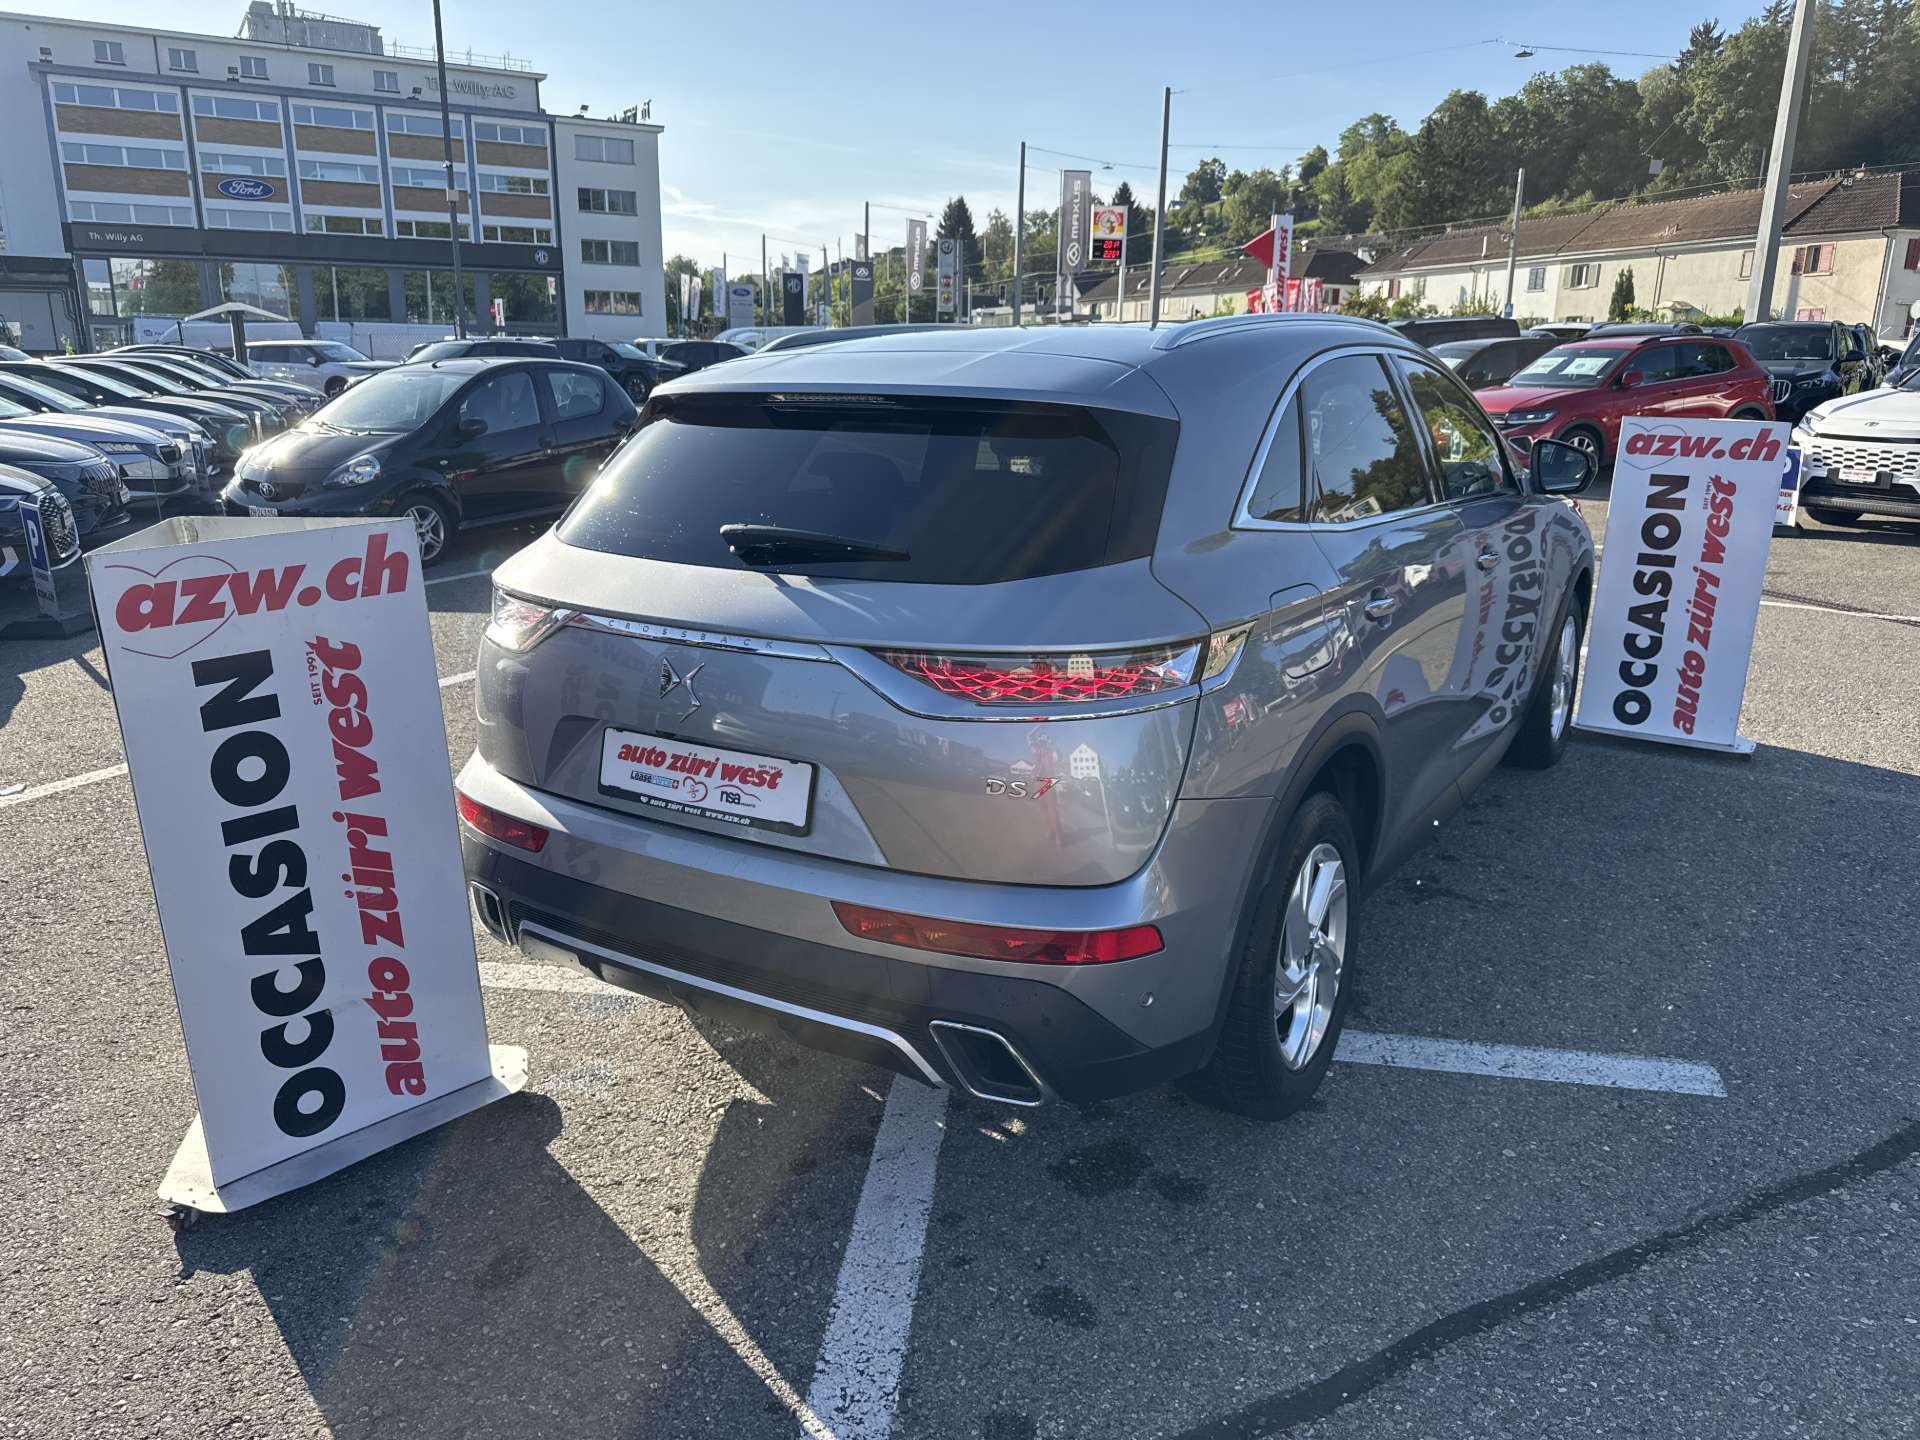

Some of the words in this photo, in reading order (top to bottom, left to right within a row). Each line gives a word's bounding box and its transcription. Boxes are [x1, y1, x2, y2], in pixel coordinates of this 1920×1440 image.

[453, 79, 489, 99] Willy
[493, 83, 516, 99] AG
[228, 179, 264, 197] Ford
[1071, 180, 1081, 239] MAXUS
[88, 231, 103, 241] Th.
[105, 232, 128, 244] Willy
[129, 233, 144, 243] AG
[1625, 428, 1781, 462] azw.ch
[1700, 474, 1737, 564] west
[115, 532, 409, 634] azw.ch
[1613, 473, 1690, 726] OCCASION
[1685, 566, 1720, 651] züri
[607, 618, 774, 649] CROSSBACK
[306, 651, 319, 678] 1991
[305, 635, 381, 801] west
[311, 682, 323, 706] SEIT
[1673, 650, 1705, 735] auto
[617, 743, 666, 768] auto
[667, 751, 721, 779] züri
[719, 763, 784, 790] west
[985, 777, 1028, 800] DS
[1031, 776, 1060, 800] 7
[720, 790, 741, 805] nsa
[190, 649, 347, 1139] OCCASION
[331, 811, 405, 949] züri
[362, 956, 427, 1096] auto
